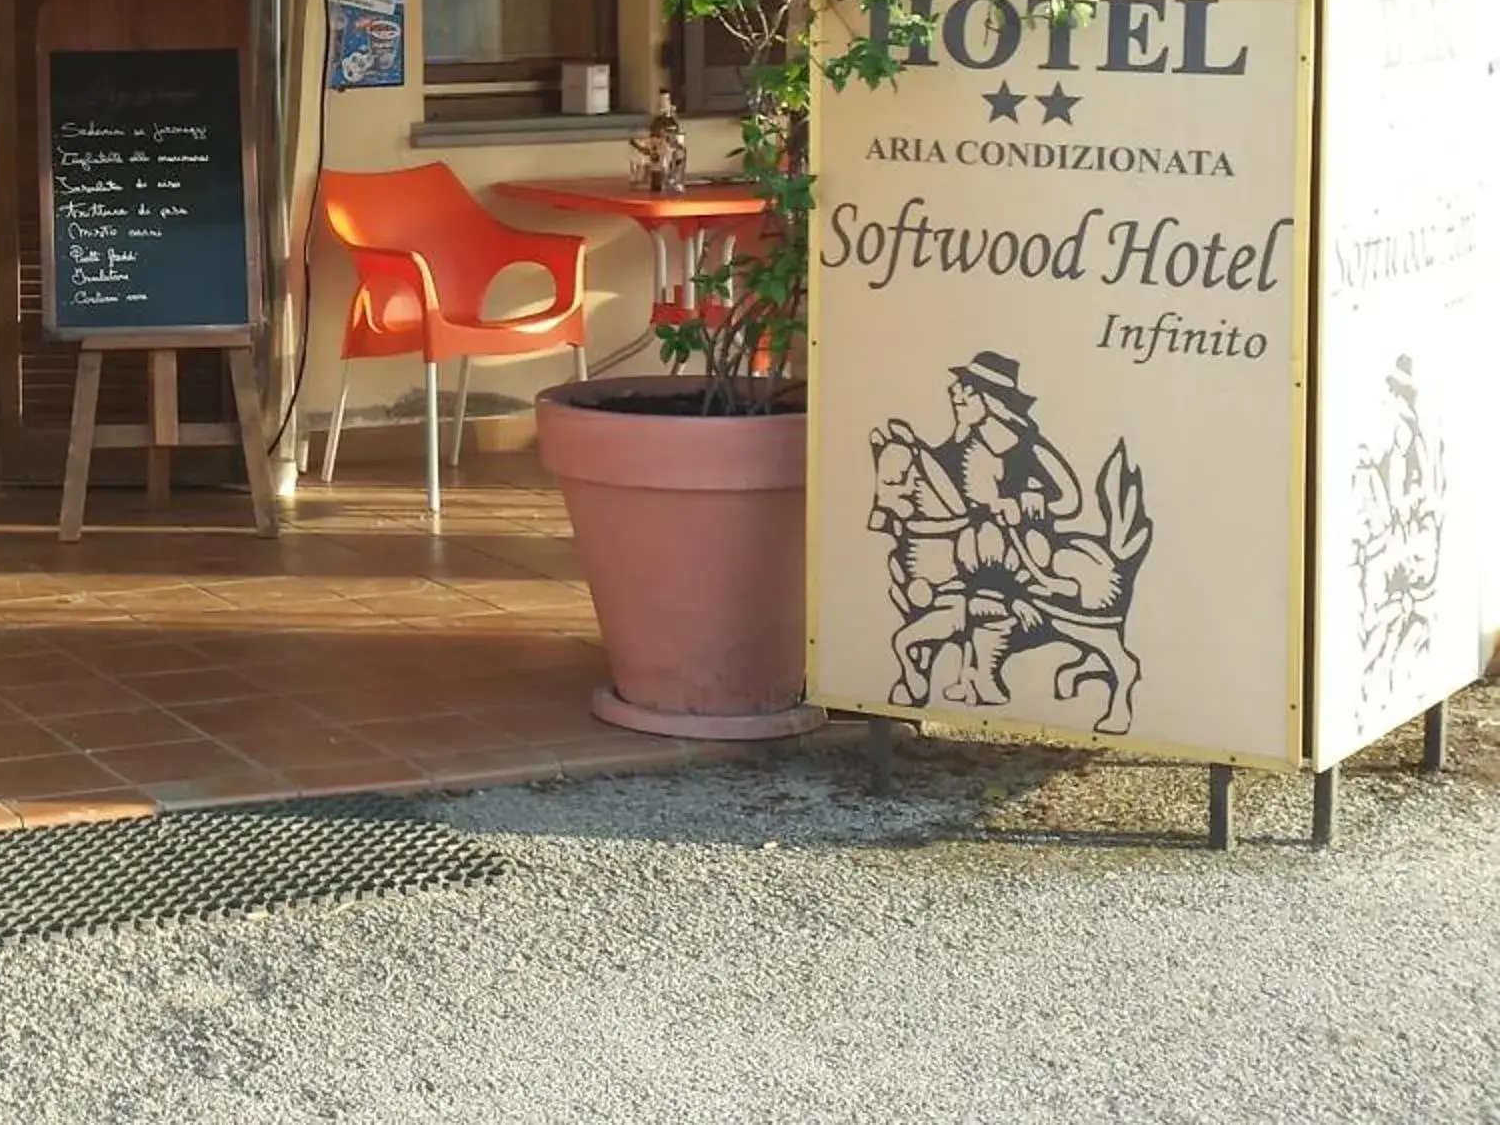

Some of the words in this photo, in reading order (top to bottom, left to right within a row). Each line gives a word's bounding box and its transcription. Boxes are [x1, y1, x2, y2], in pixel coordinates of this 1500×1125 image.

[865, 137, 947, 165] ARIA
[955, 140, 1235, 177] CONDIZIONATA
[820, 198, 1104, 290] Softwood
[1100, 216, 1295, 292] Hotel
[1096, 312, 1267, 364] Infinito
